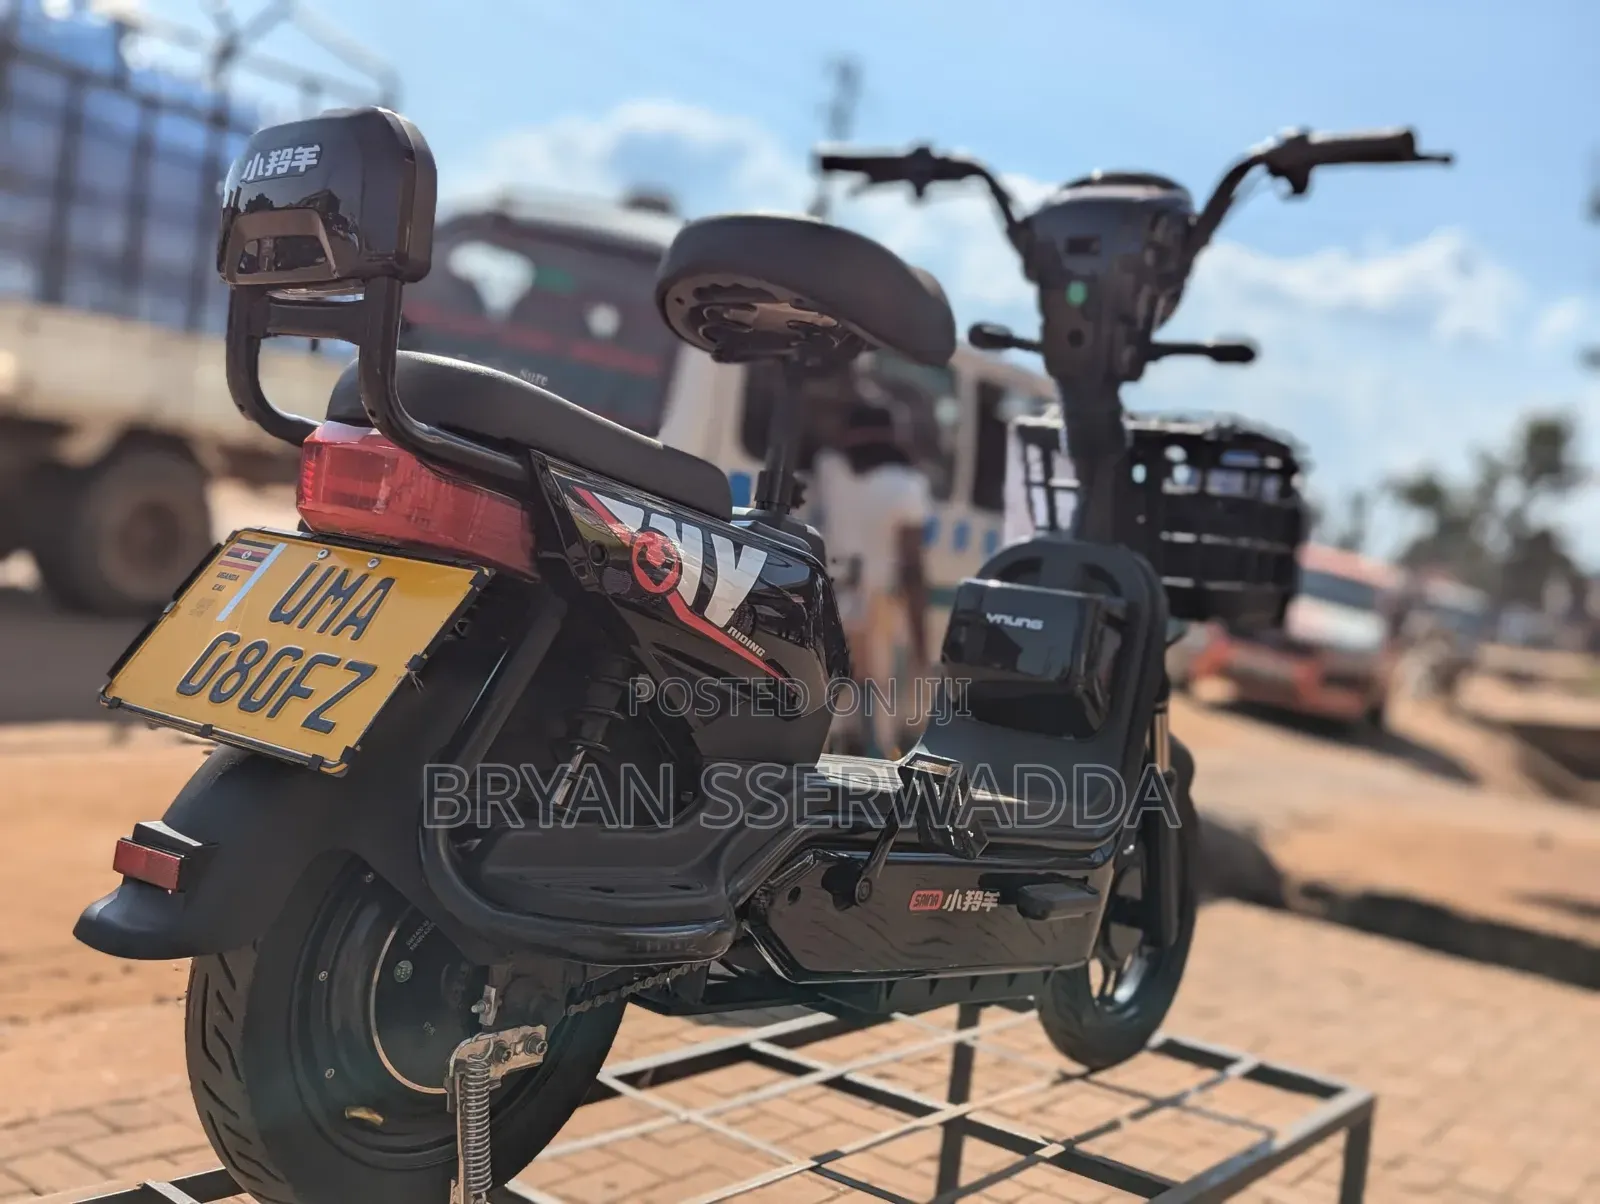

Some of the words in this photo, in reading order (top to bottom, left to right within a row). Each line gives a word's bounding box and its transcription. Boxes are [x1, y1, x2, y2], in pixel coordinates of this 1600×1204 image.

[242, 144, 321, 181] 小羚羊
[216, 571, 240, 582] UGANDA
[268, 561, 397, 641] UMA
[726, 626, 766, 657] RIDING
[175, 630, 378, 735] 080FZ
